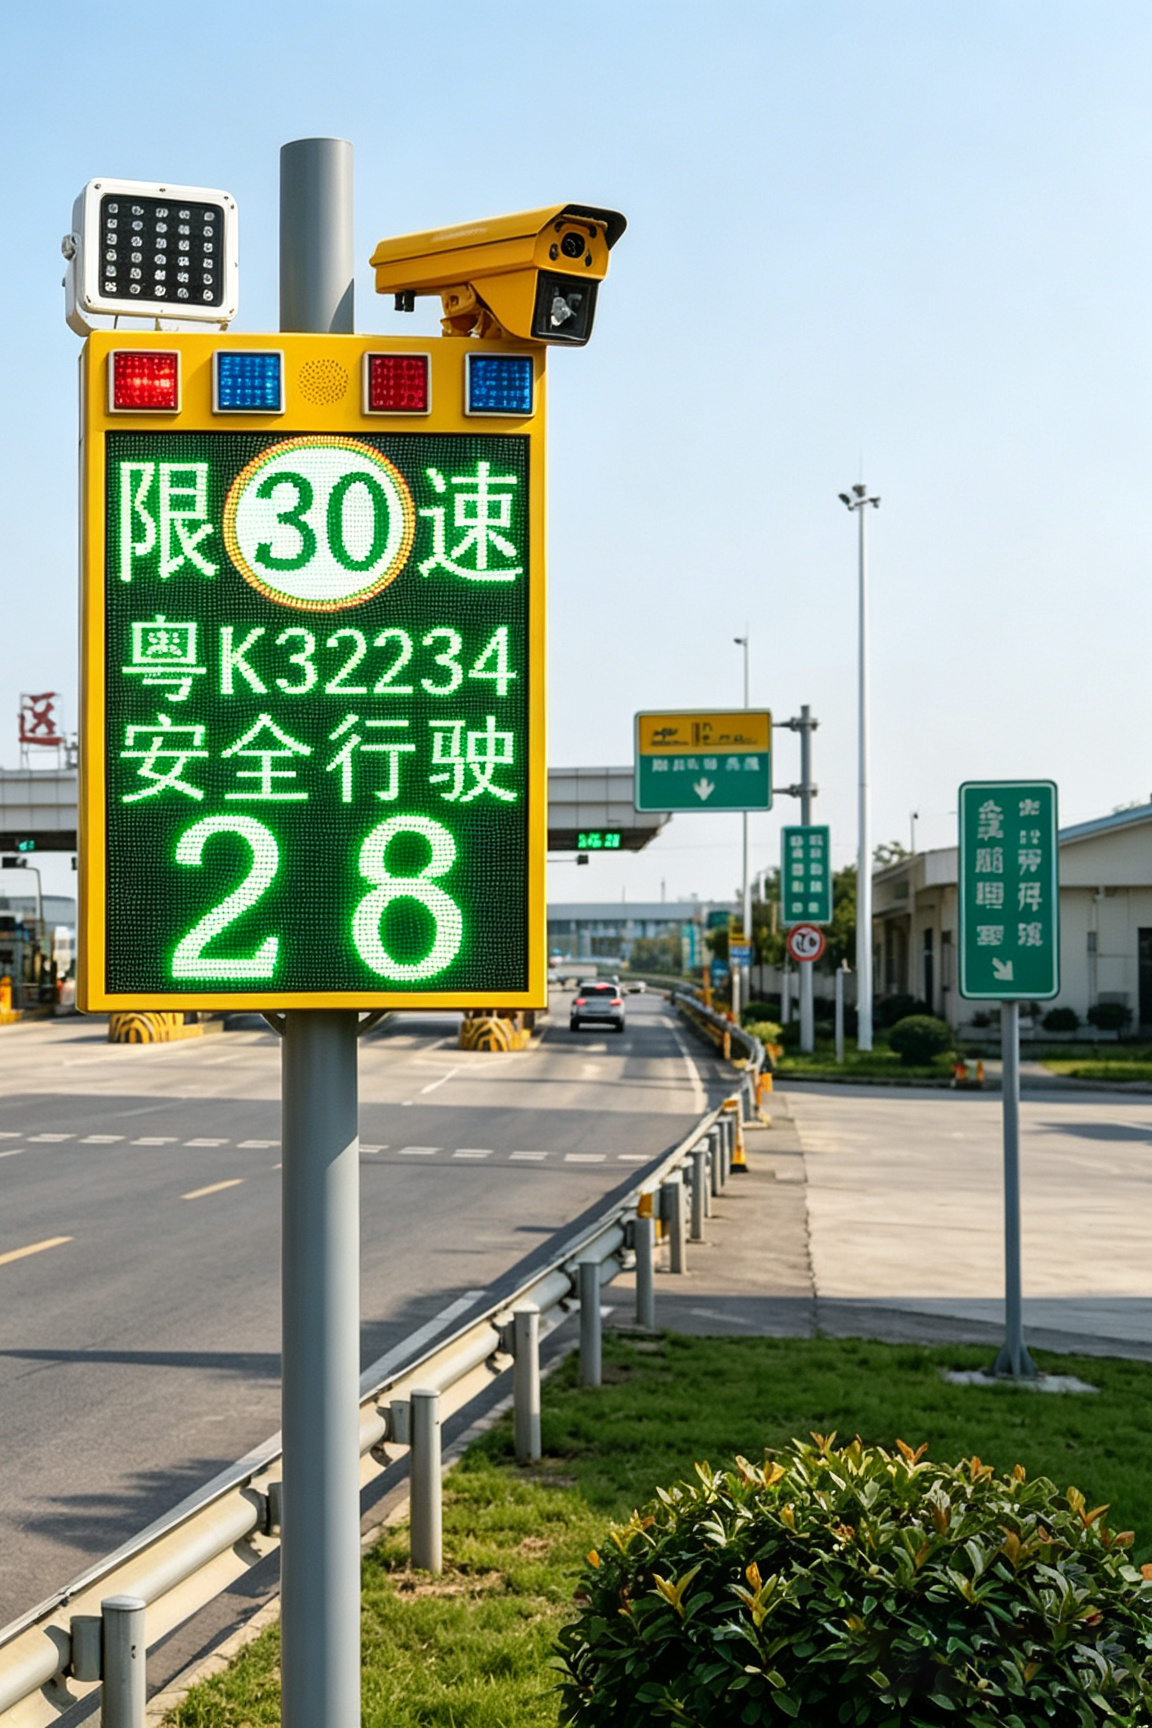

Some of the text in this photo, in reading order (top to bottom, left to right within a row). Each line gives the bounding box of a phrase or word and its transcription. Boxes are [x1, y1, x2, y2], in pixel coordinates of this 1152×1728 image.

[118, 461, 524, 584] 限 30 速
[119, 712, 518, 803] 安全行驶
